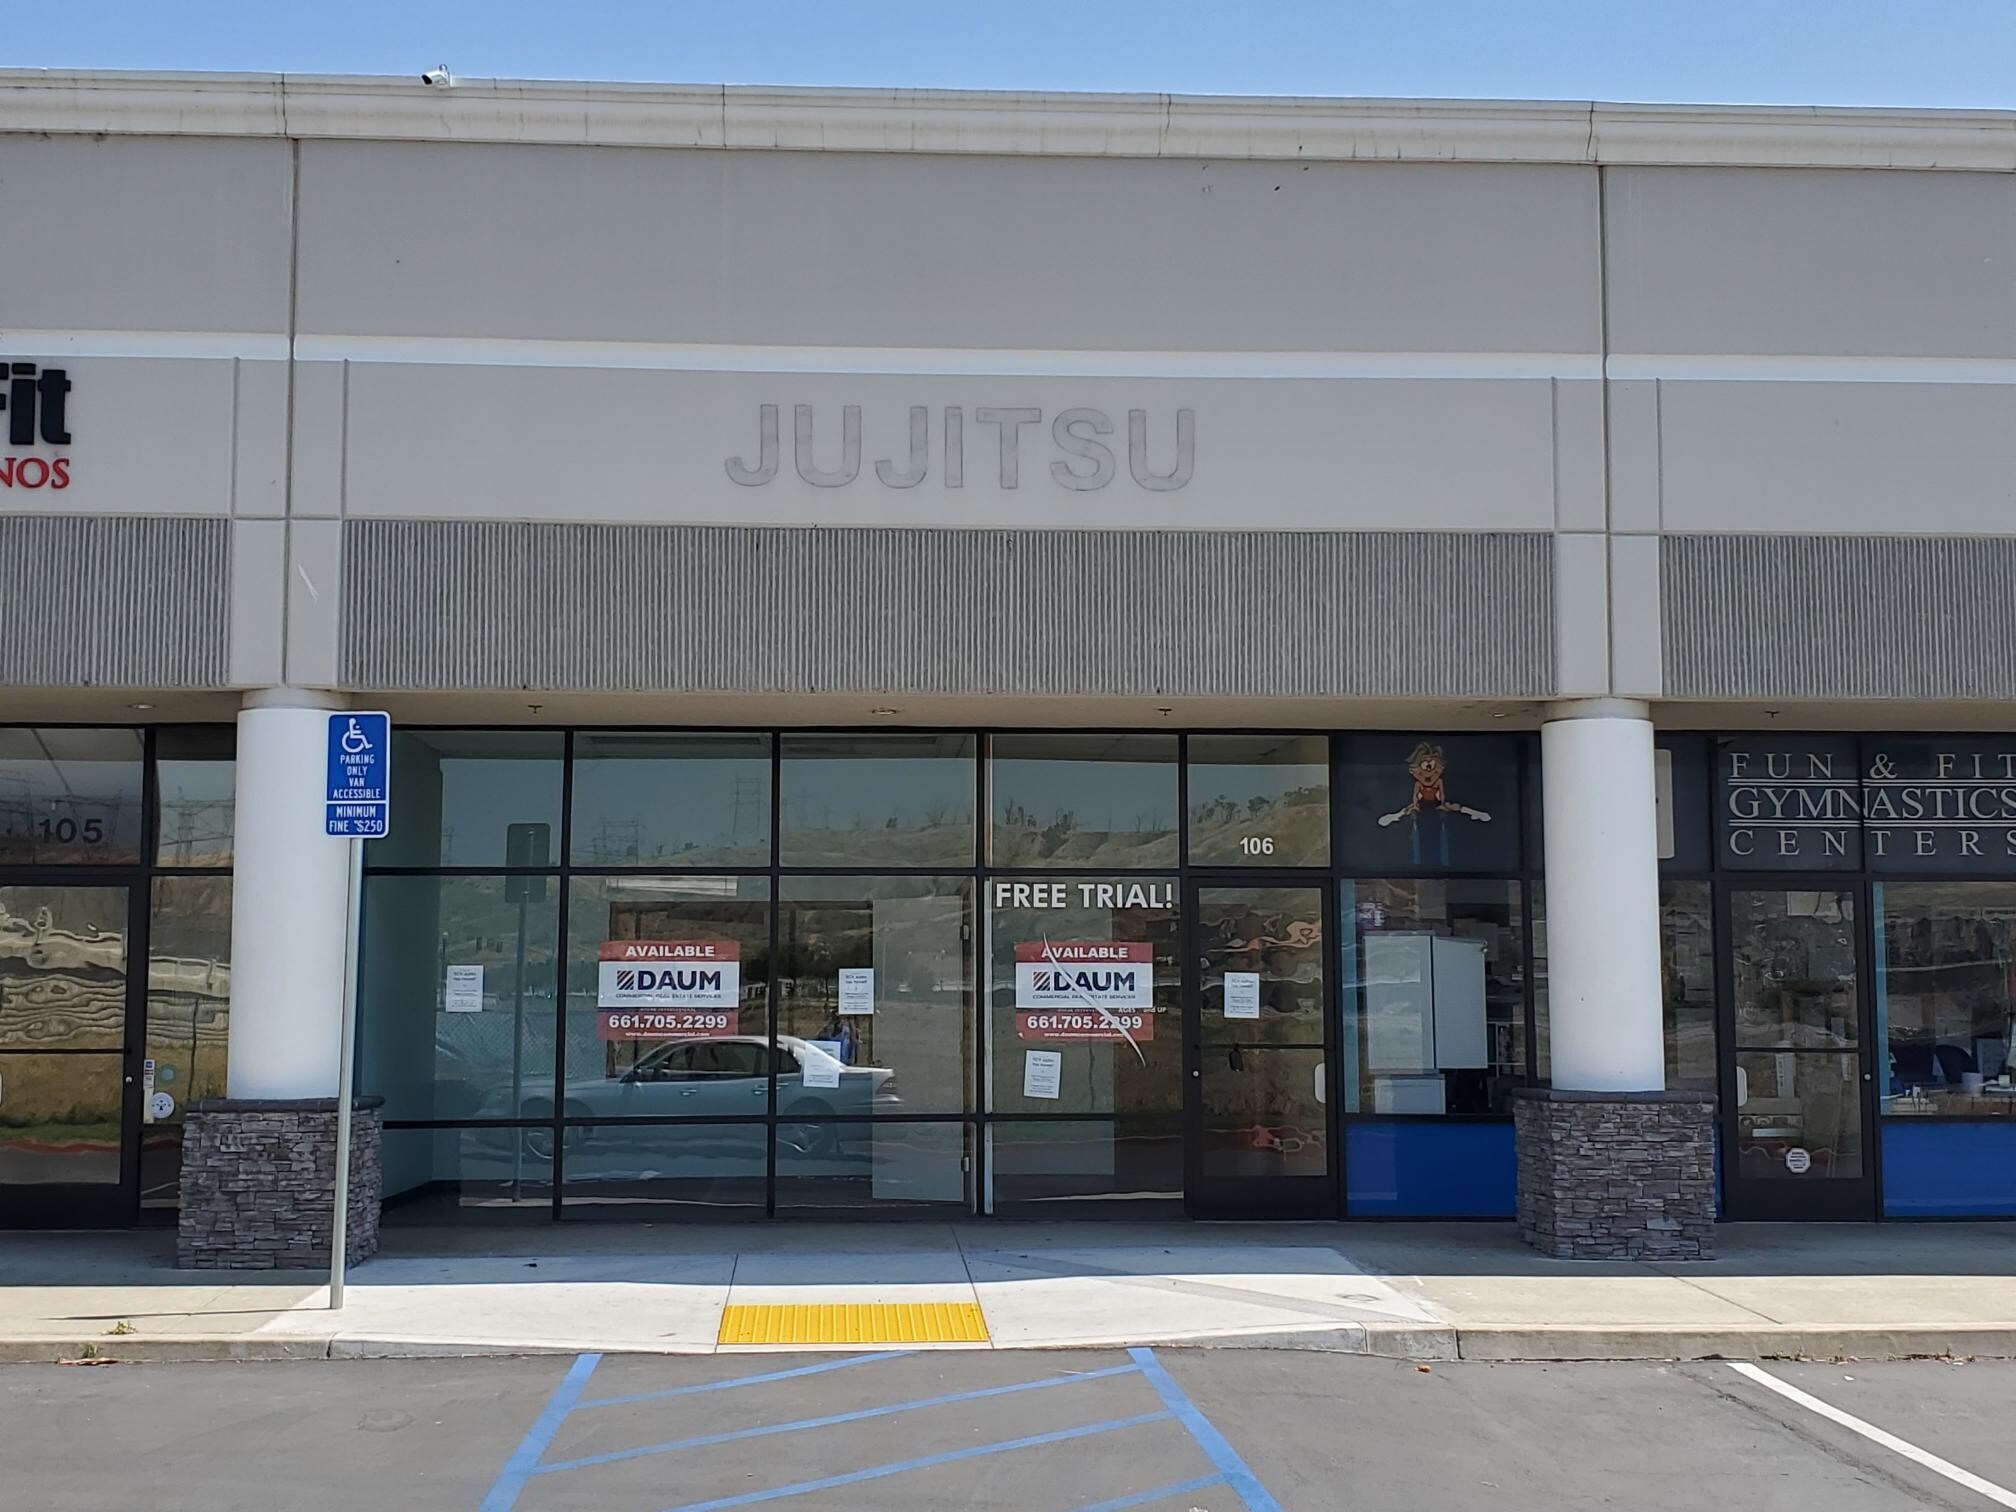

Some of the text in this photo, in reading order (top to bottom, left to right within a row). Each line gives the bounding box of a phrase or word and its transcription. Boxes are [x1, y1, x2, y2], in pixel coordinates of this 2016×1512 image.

[0, 363, 71, 445] it
[725, 403, 1196, 492] JUJITSU
[340, 754, 375, 765] PARKING
[1729, 753, 2016, 779] FUN & FIT
[346, 766, 368, 776] ONLY
[348, 777, 365, 787] VAN
[332, 788, 381, 799] ACCESSIBLE
[1729, 787, 2016, 819] GYMNASTICS
[336, 805, 376, 818] MINIMUM
[38, 818, 103, 844] 105
[329, 820, 349, 832] FINE
[1240, 837, 1274, 855] 106
[996, 883, 1173, 909] FREE TRIAL!
[626, 945, 715, 957] AVAILABLE
[1041, 947, 1129, 959] AVAILABLE
[637, 970, 721, 991] DAUM
[1053, 971, 1135, 992] DAUM
[608, 1014, 728, 1029] 661.705.2299
